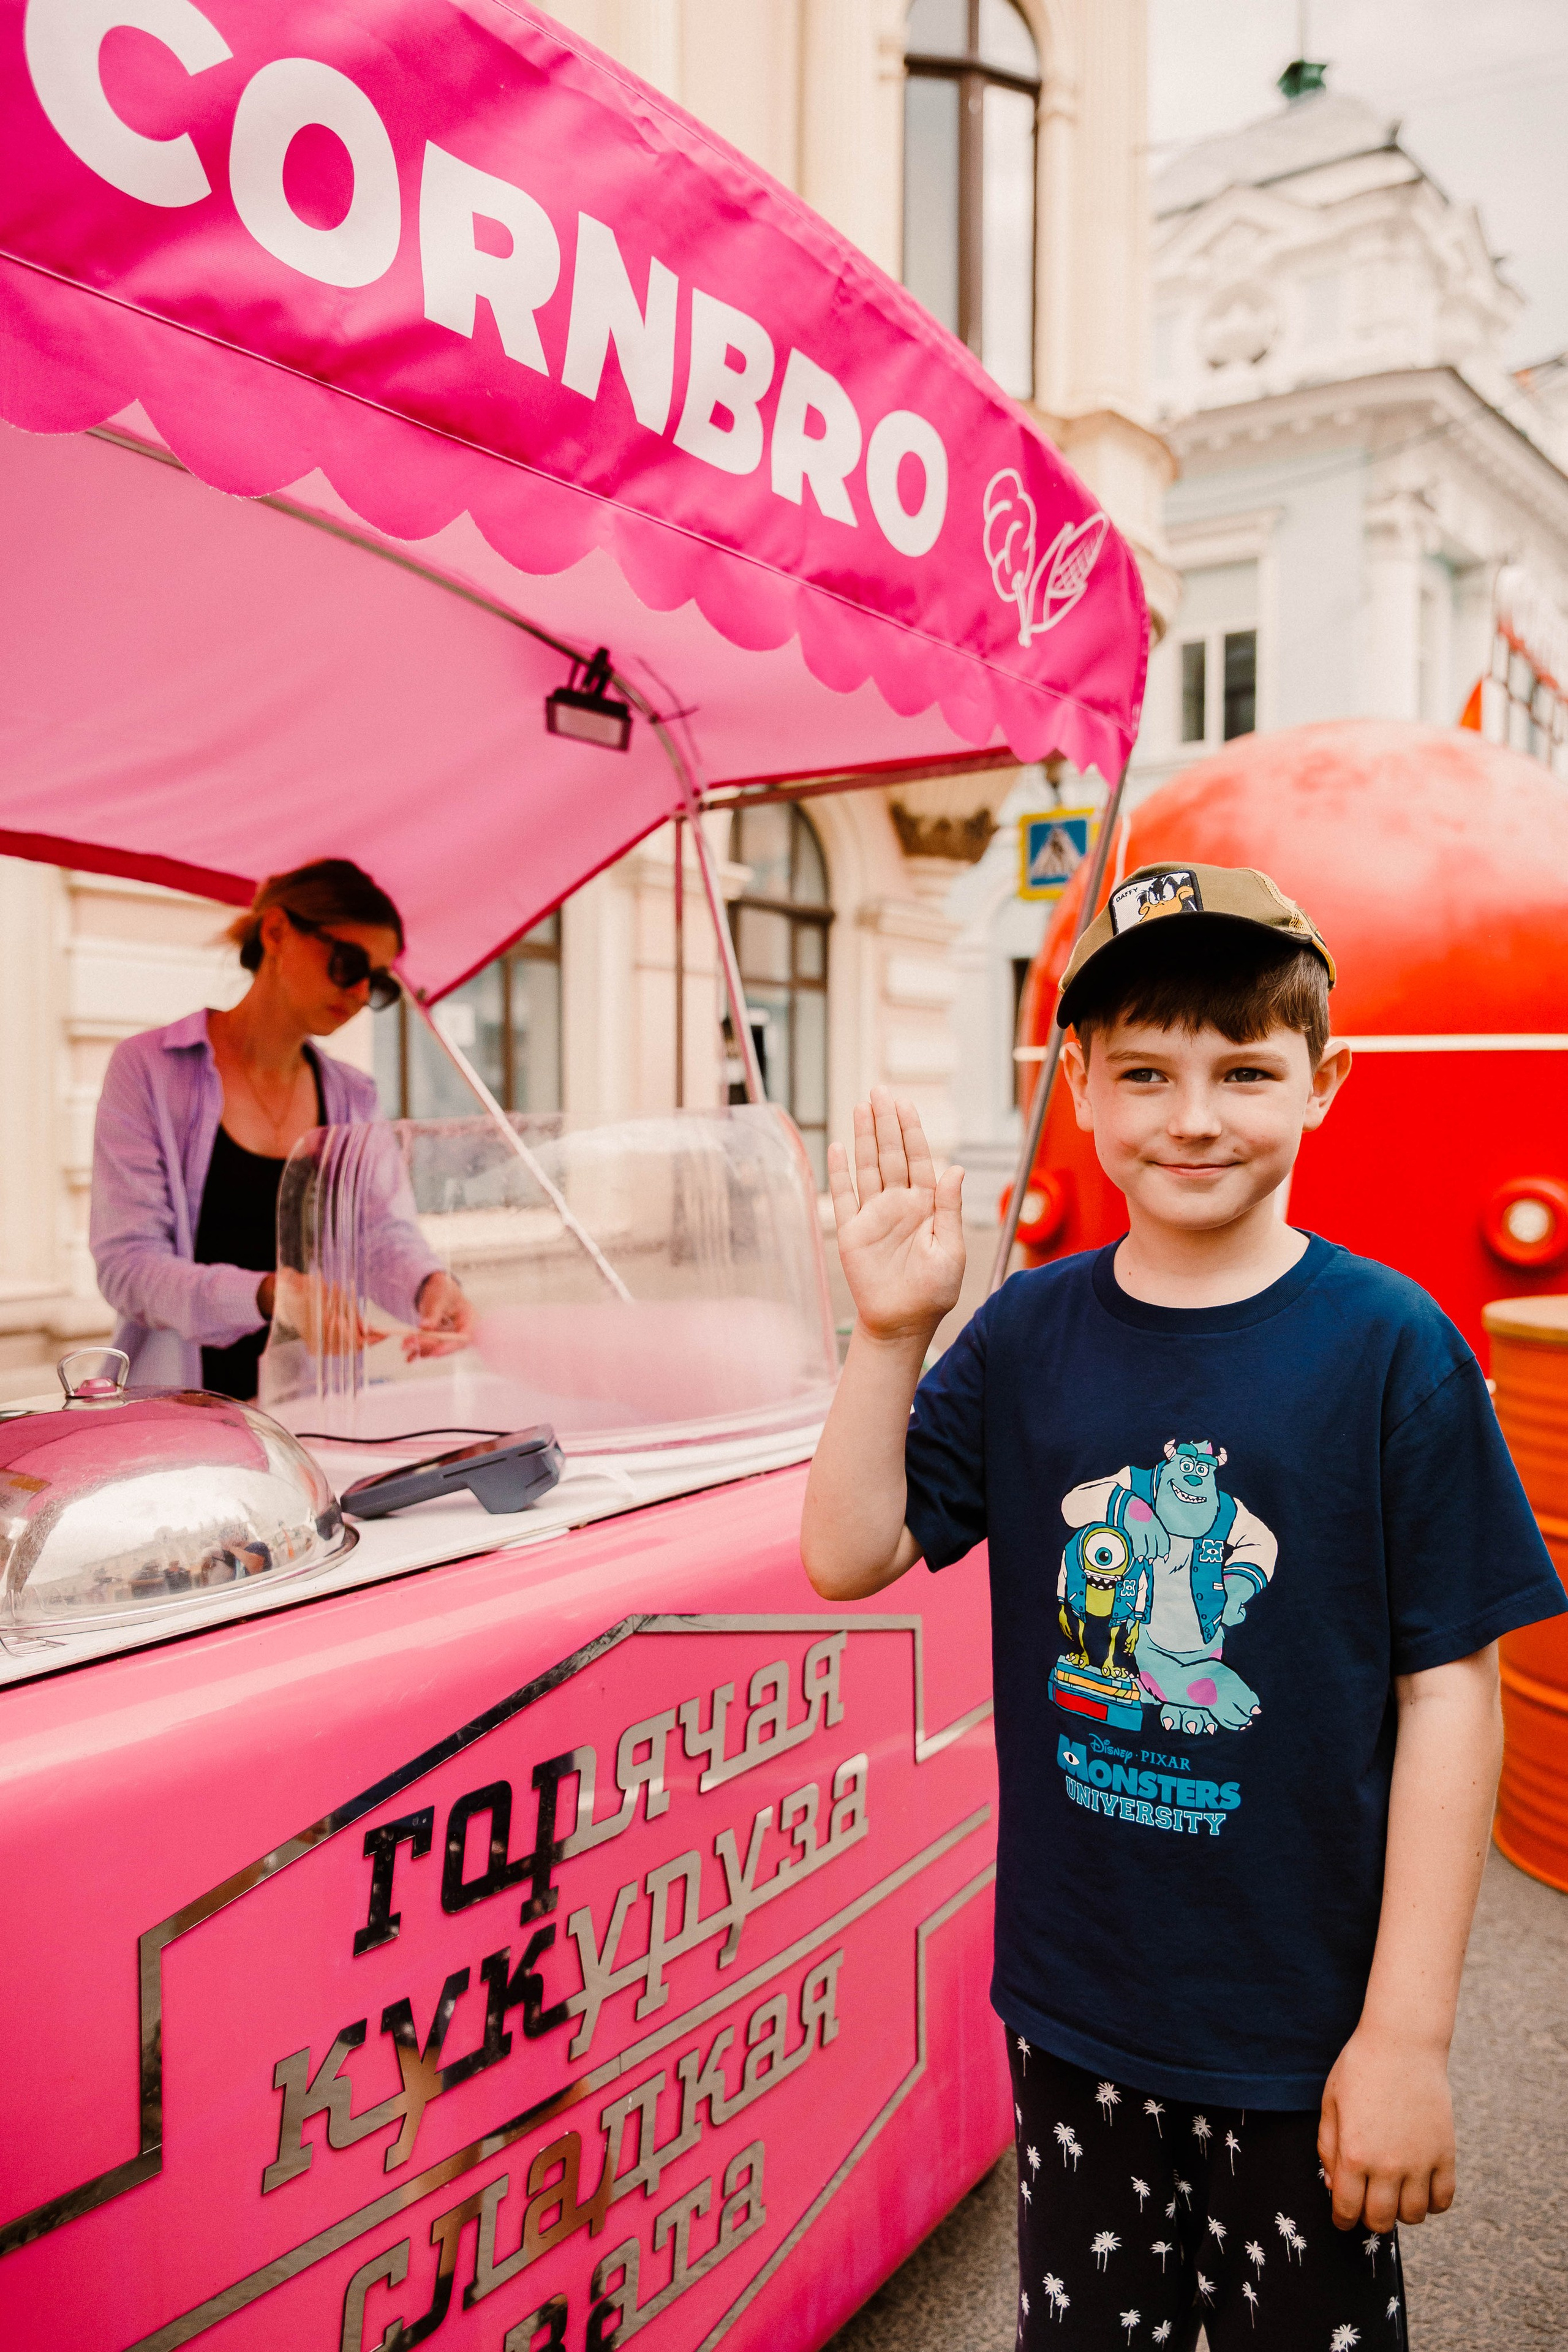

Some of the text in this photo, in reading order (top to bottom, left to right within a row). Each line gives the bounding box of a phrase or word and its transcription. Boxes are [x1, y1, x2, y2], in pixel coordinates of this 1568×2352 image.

[24, 0, 948, 557] CORNBRO
[1115, 887, 1138, 902] DAFFY
[1057, 1733, 1241, 1810] MONSTERS
[1140, 1750, 1191, 1771] PIXAR
[1066, 1776, 1226, 1836] UNIVERSITY
